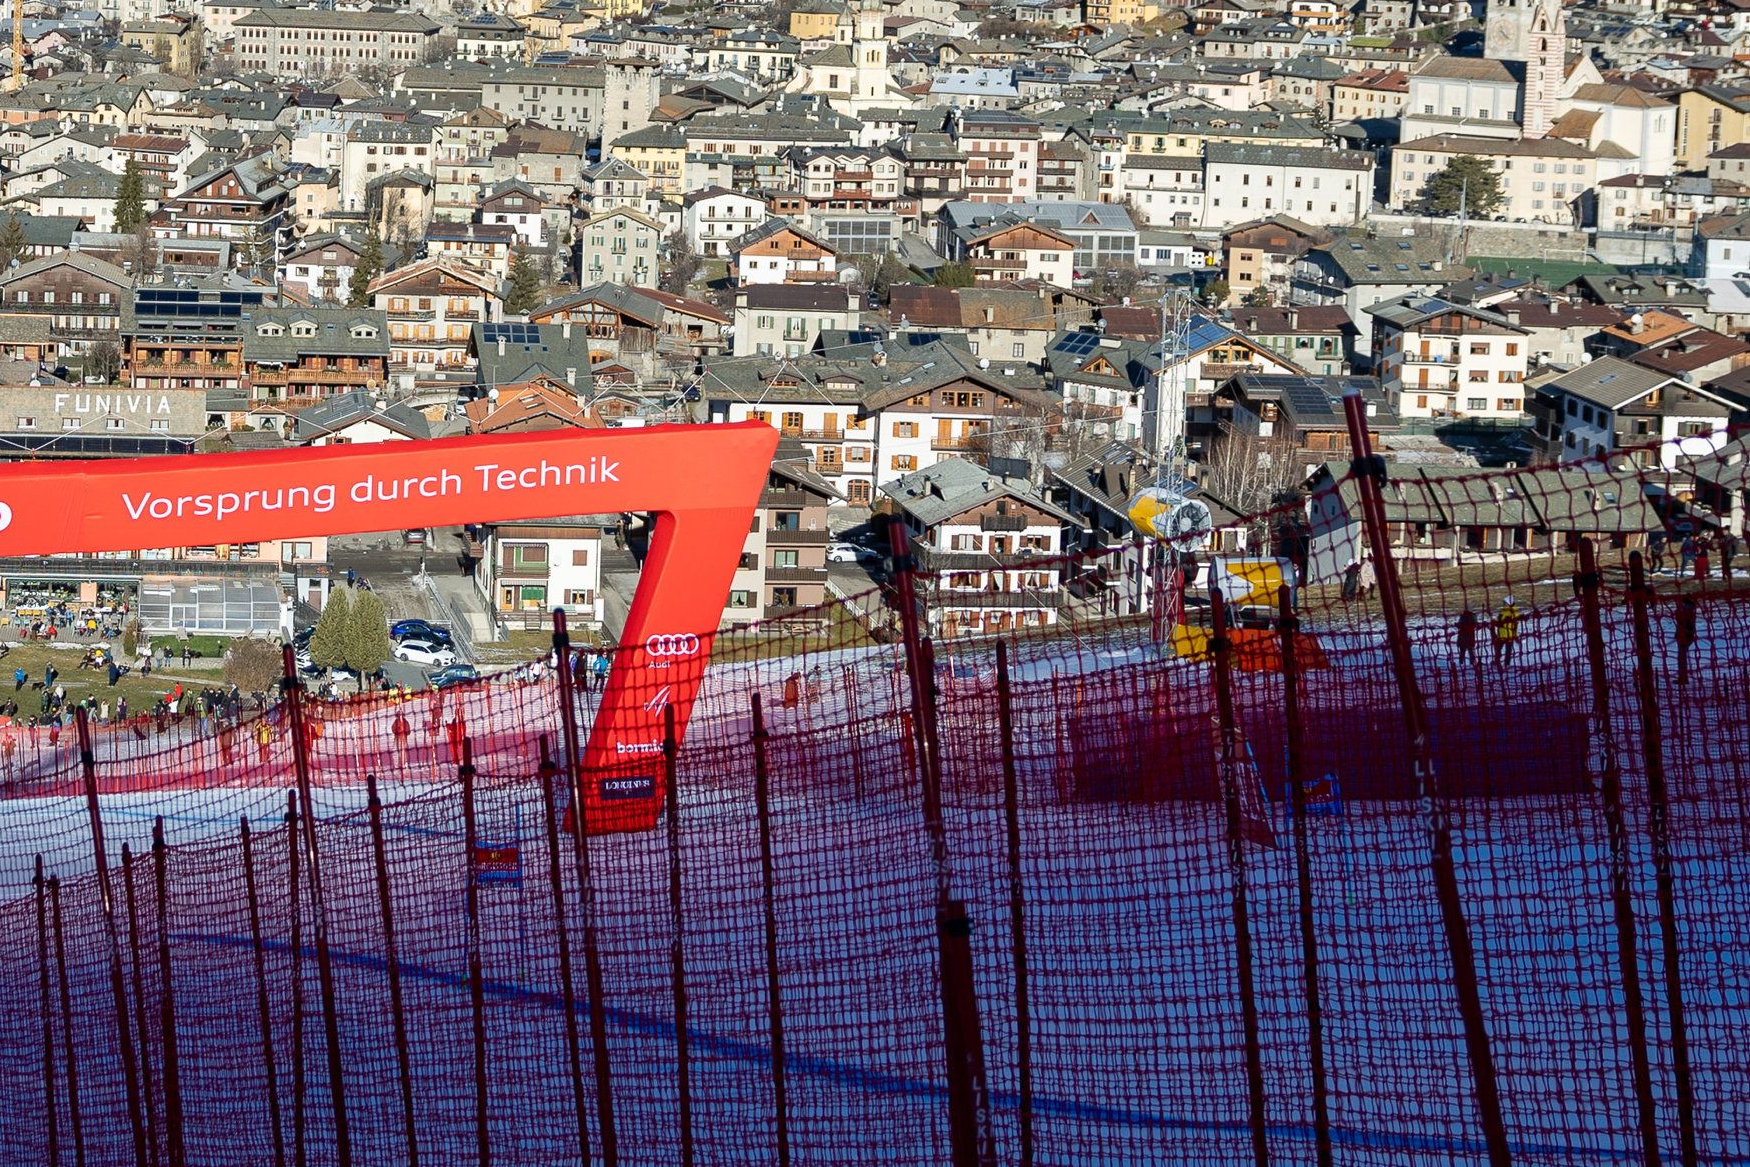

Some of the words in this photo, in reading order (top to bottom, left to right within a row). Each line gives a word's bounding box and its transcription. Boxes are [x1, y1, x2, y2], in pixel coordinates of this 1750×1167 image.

[54, 392, 171, 415] FUNIVIA
[122, 479, 336, 521] Vorsprung
[350, 468, 462, 504] durch
[474, 456, 621, 493] Technik
[648, 660, 671, 669] Audi
[1415, 759, 1436, 850] LISKI
[972, 1075, 988, 1155] LISKI
